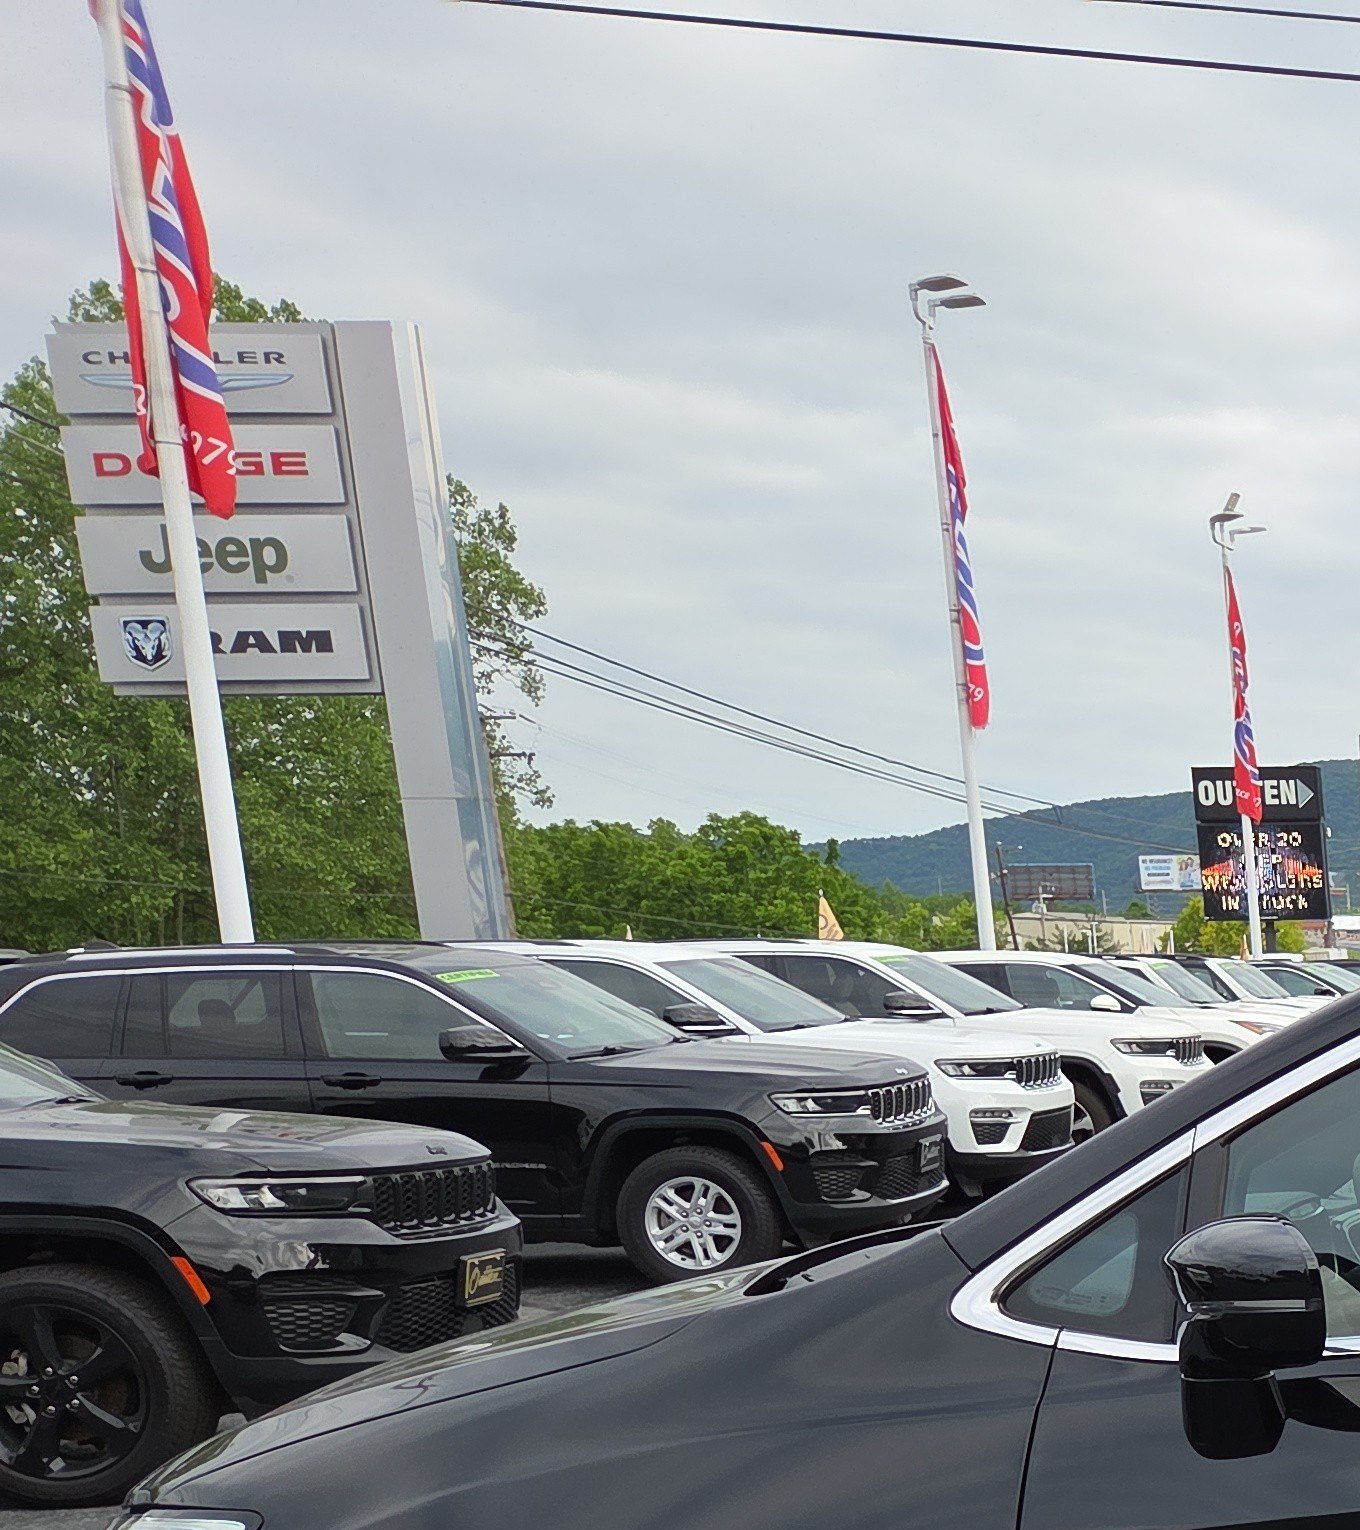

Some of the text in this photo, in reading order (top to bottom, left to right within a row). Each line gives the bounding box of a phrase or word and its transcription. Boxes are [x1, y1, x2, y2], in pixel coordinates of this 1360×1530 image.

[81, 351, 287, 365] CHLER
[92, 451, 309, 477] DGE
[1197, 780, 1297, 806] OUEN
[1217, 831, 1302, 848] OVR 20
[1262, 894, 1308, 910] TOCK
